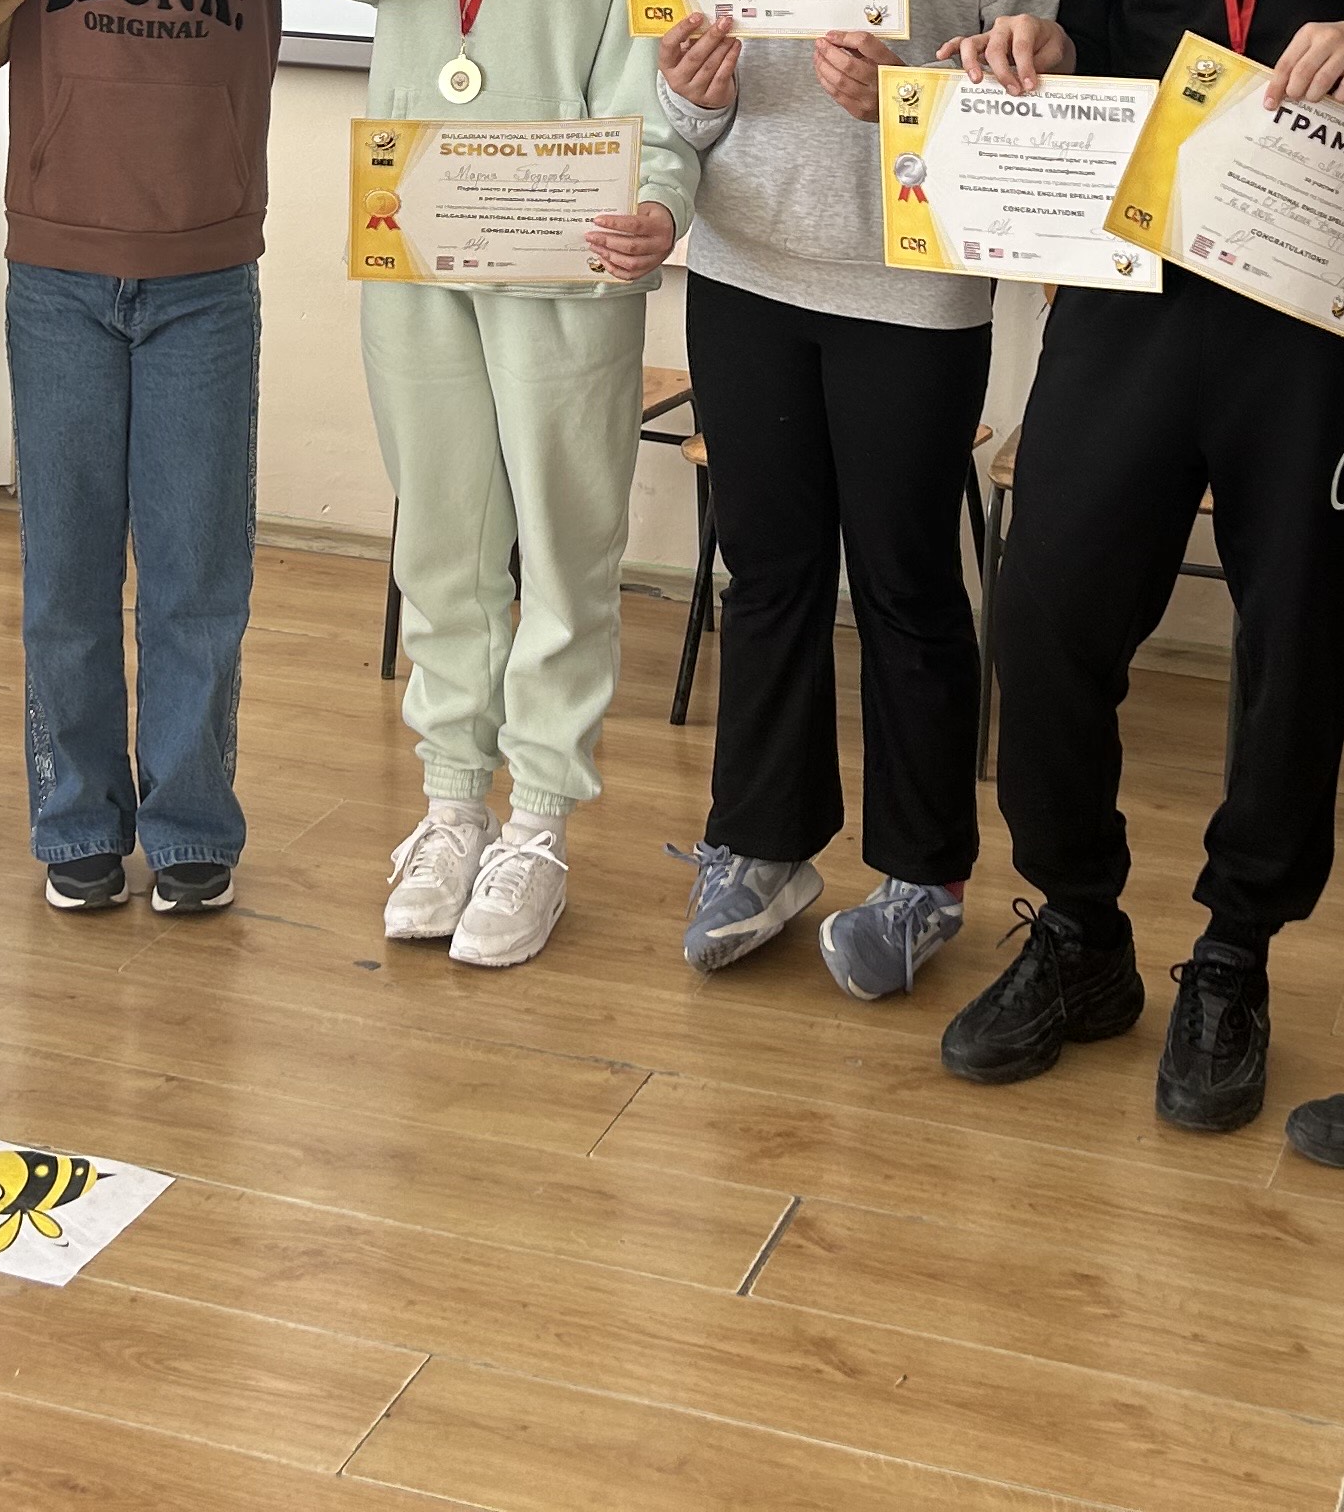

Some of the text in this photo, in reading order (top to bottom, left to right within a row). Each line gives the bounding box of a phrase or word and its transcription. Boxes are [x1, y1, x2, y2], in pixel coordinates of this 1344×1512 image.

[84, 11, 208, 39] ORIGINAL
[960, 98, 1135, 123] SCHOOL WINNER
[439, 141, 620, 156] SCHOOL WINNER
[1003, 205, 1085, 217] CONGRATULATIONS!
[481, 227, 563, 236] CONGRATULATIONS!
[1251, 227, 1329, 266] CONGRATULATIONS!
